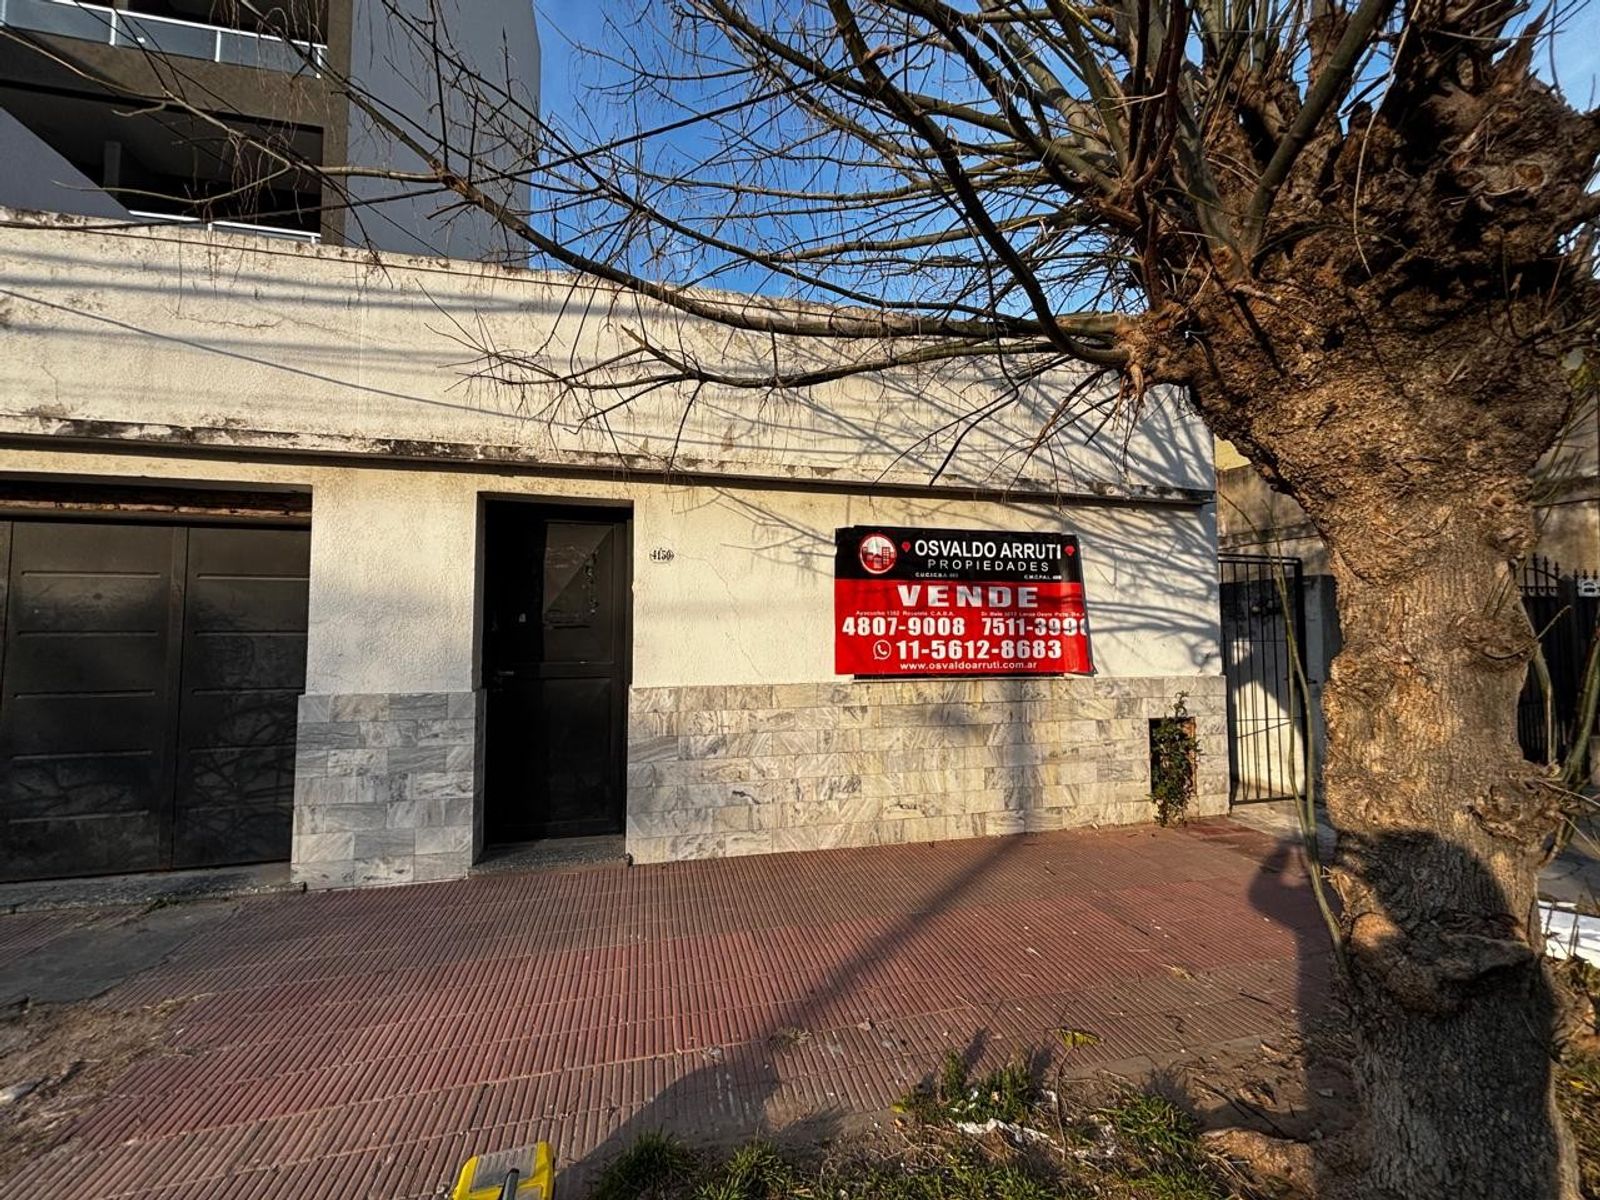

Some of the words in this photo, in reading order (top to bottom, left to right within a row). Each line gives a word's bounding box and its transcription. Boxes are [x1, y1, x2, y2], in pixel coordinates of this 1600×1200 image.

[914, 539, 997, 558] OSVALDO
[999, 542, 1062, 560] ARRUTI
[927, 558, 1050, 573] PROPIEDADES
[897, 584, 1038, 608] VENDE
[842, 616, 966, 637] 4807-9008
[895, 640, 1063, 660] 11-5612-8683
[900, 660, 1038, 671] www.osvaldoarruti.com.ar
